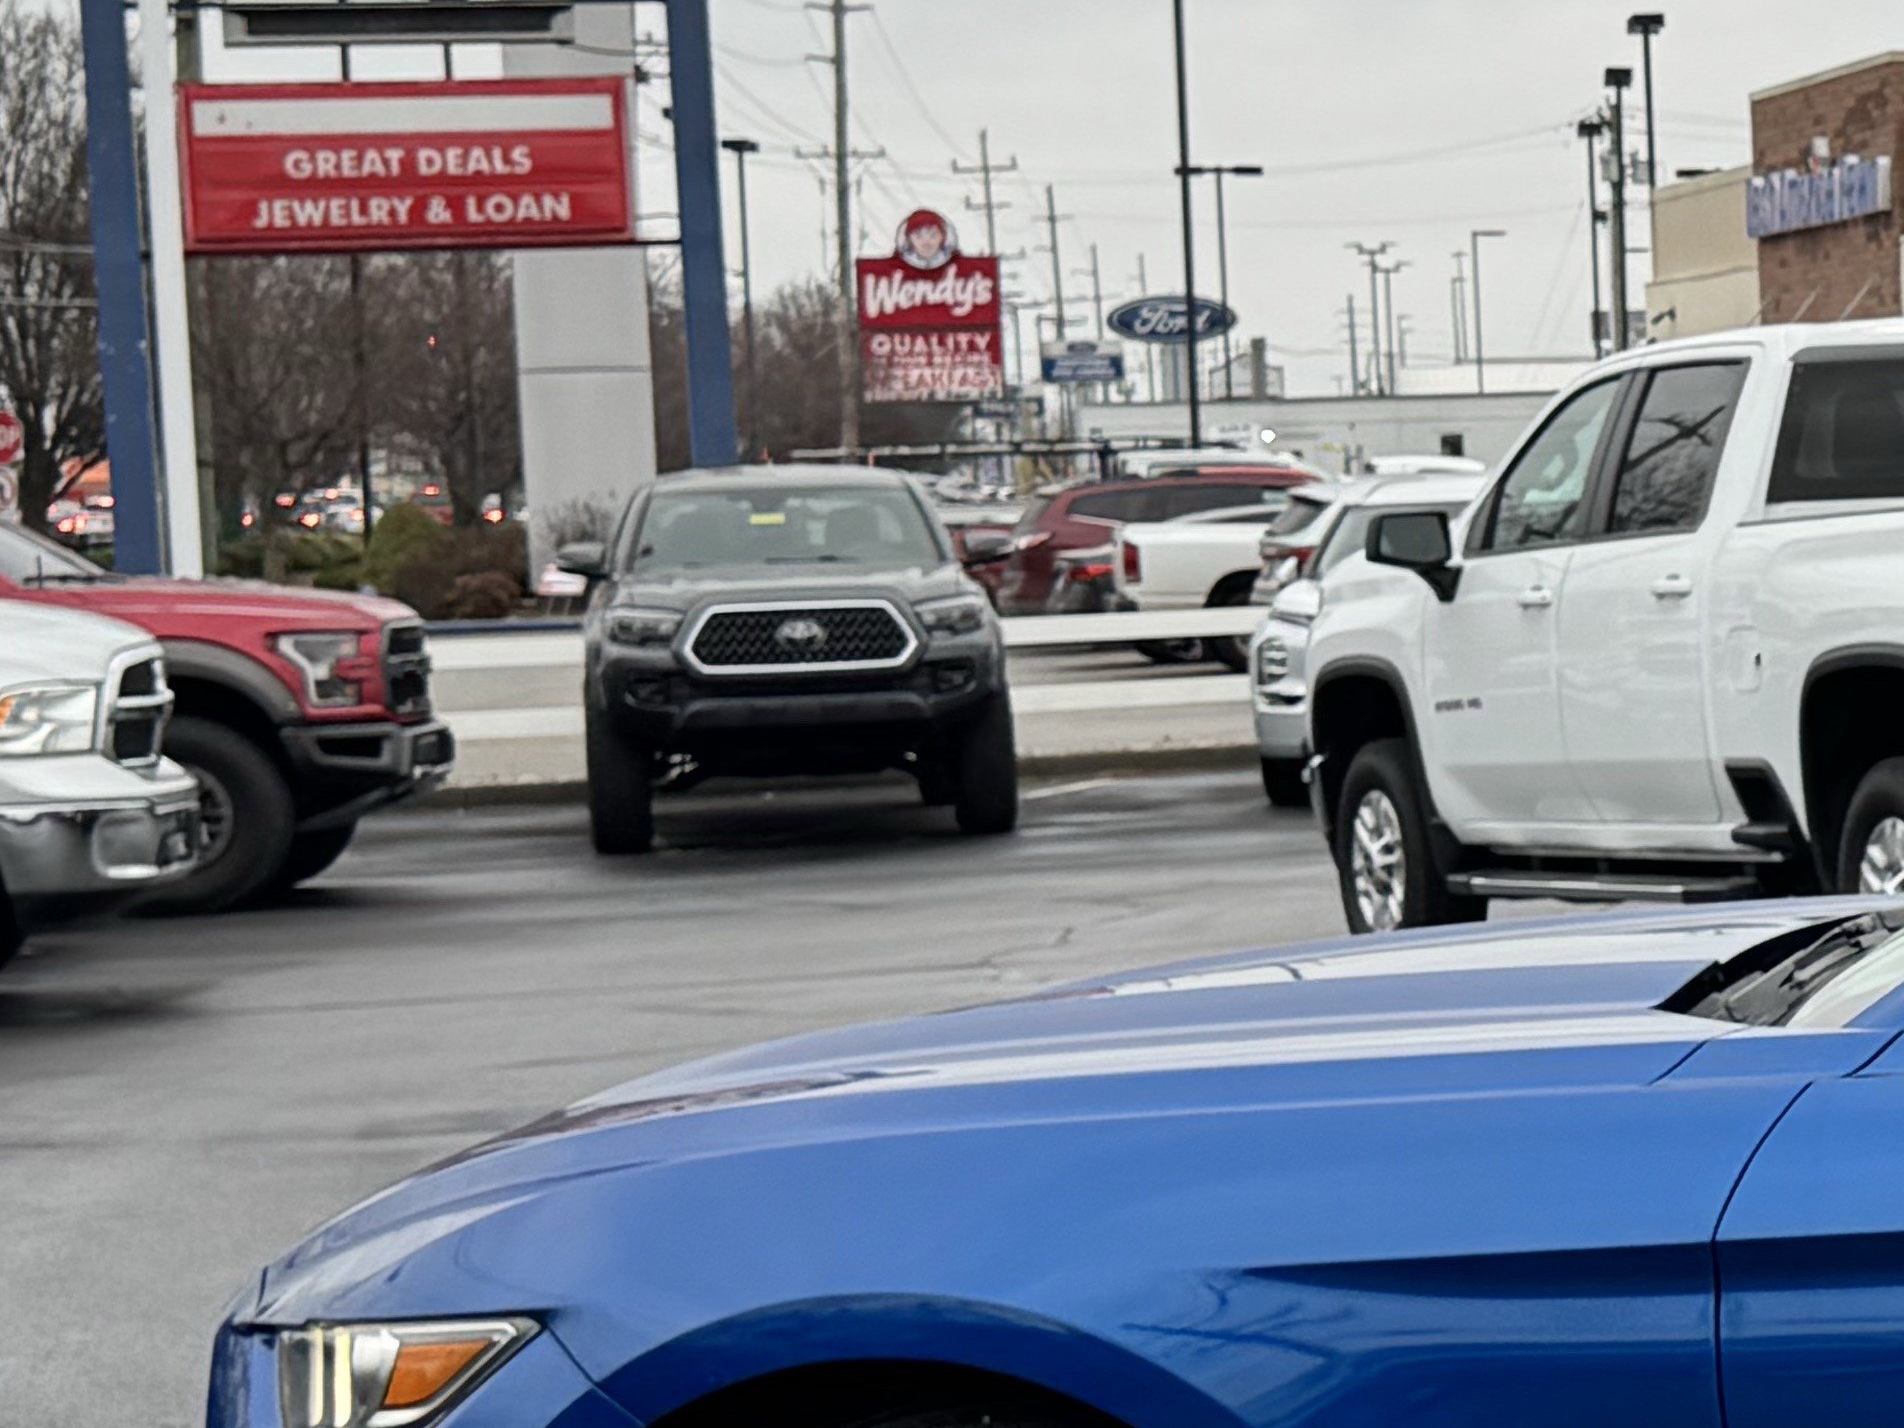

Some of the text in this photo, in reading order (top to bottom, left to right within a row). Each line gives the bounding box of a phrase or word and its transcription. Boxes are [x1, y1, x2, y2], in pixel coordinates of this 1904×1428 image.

[284, 145, 533, 180] GREAT DEALS
[252, 194, 572, 230] JEWELRY & LOAN
[864, 264, 994, 319] Wendy's
[870, 332, 990, 356] QUALITY
